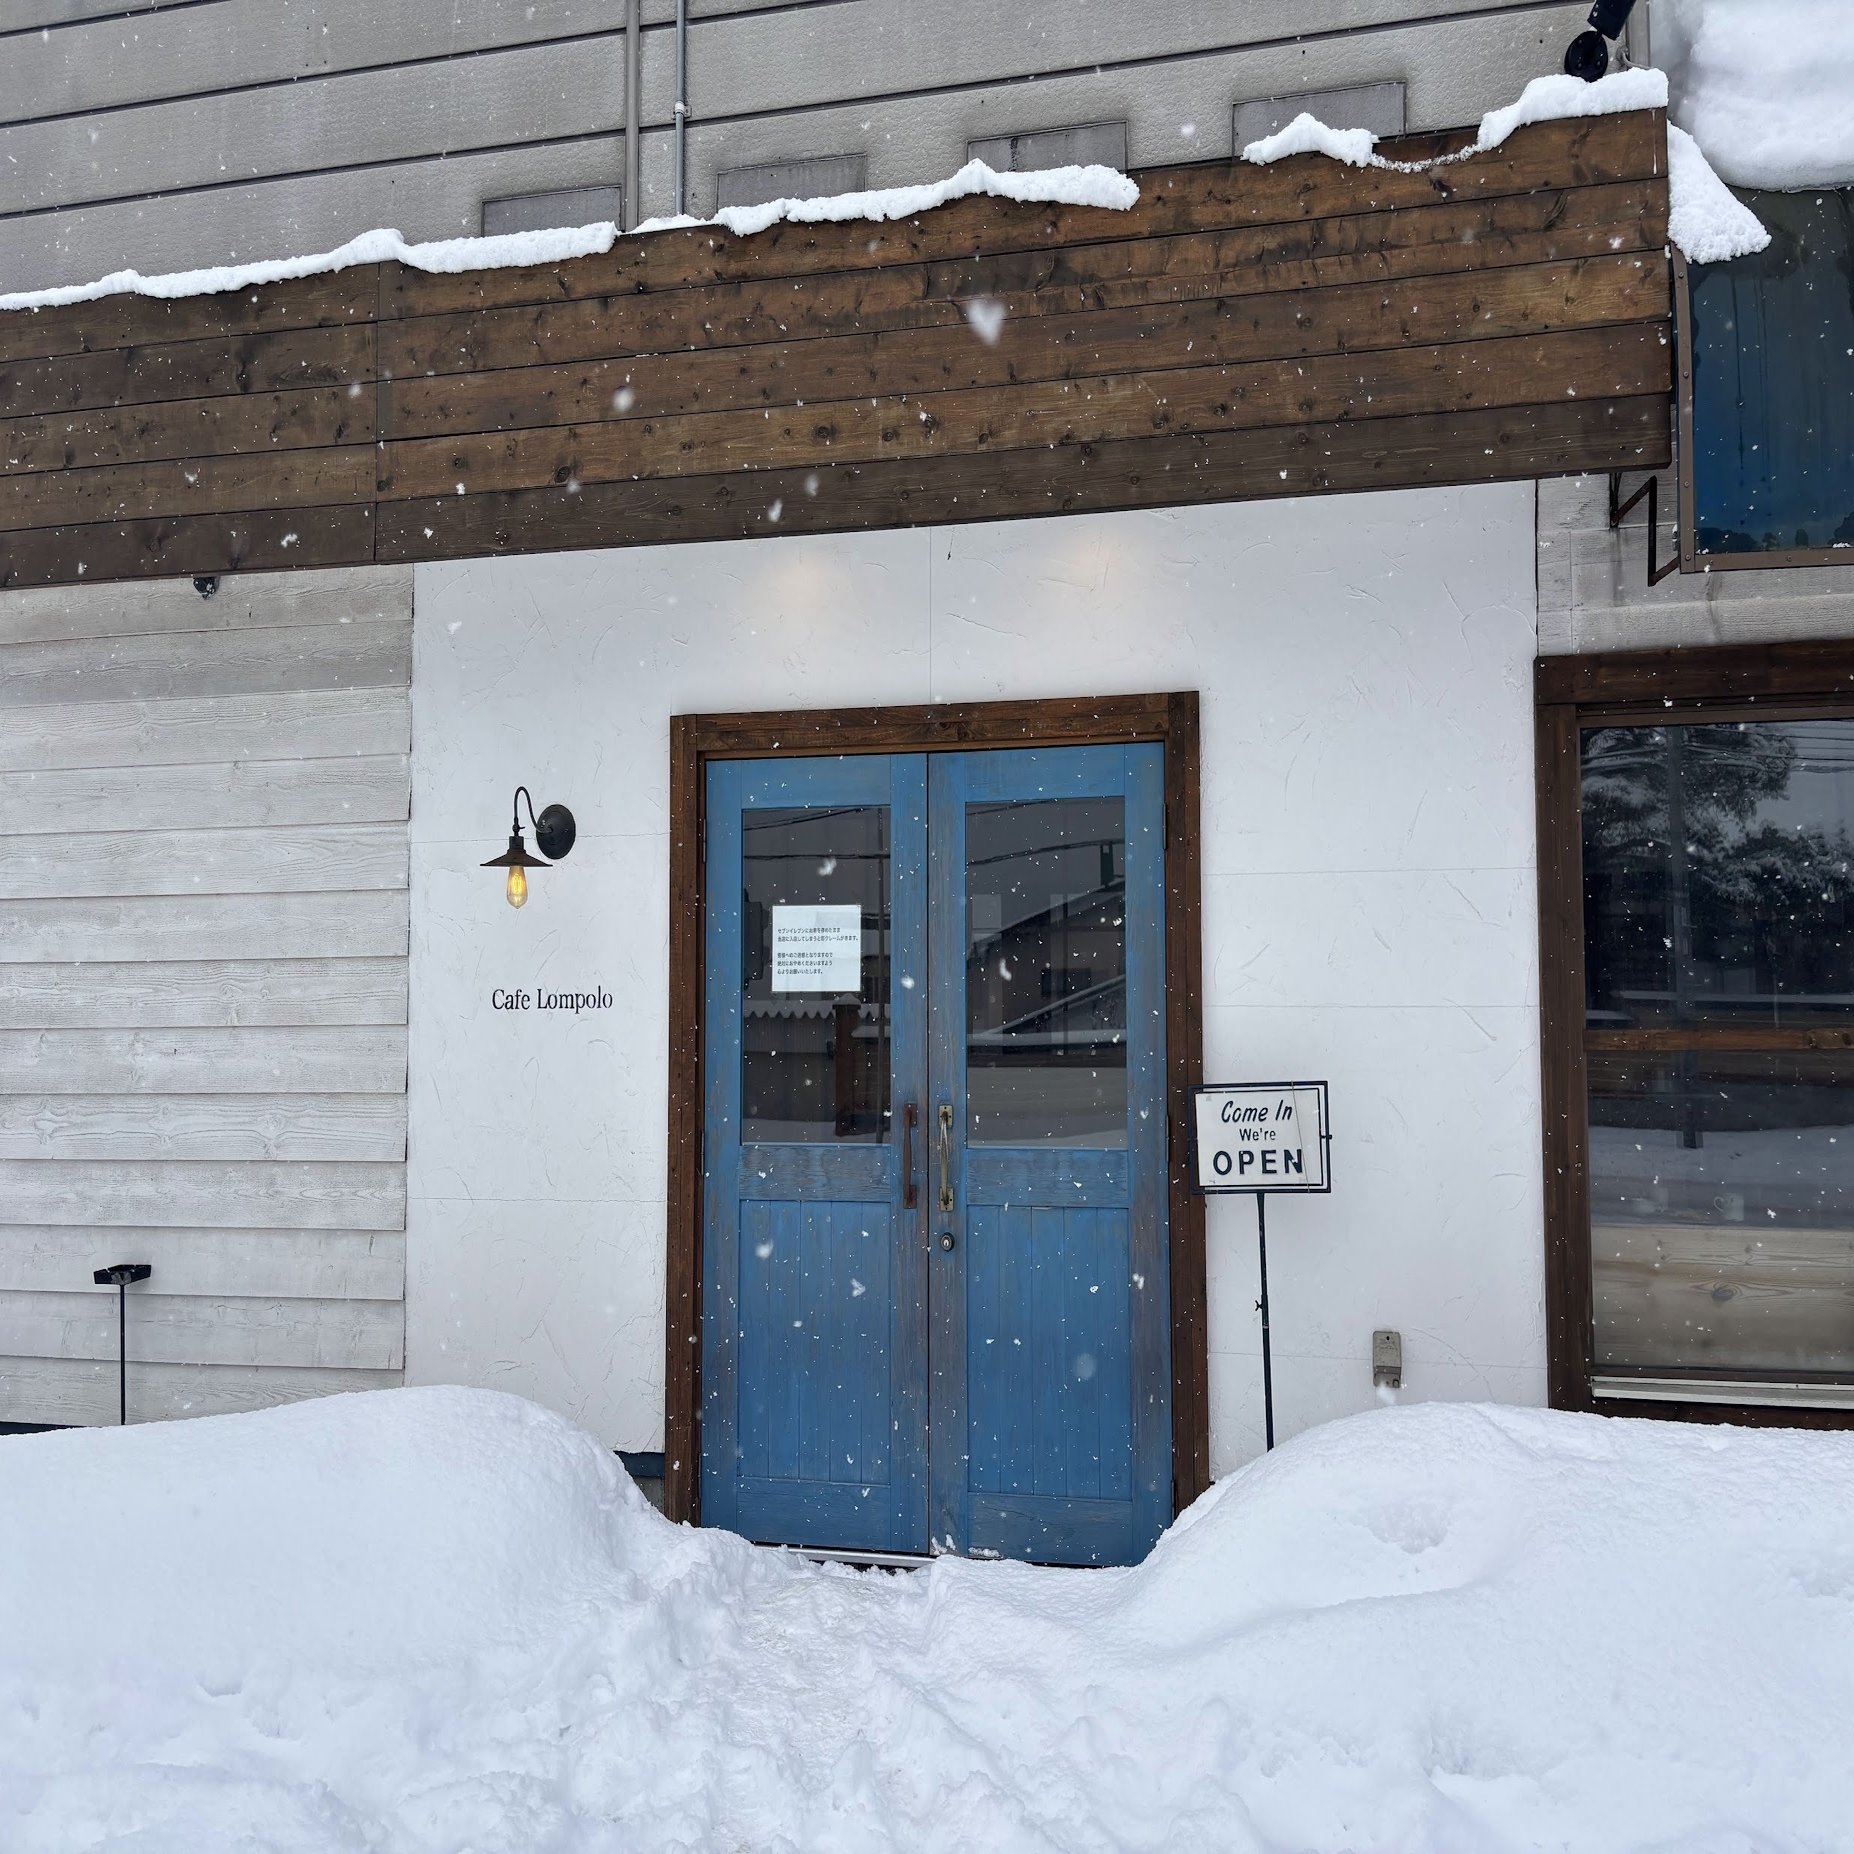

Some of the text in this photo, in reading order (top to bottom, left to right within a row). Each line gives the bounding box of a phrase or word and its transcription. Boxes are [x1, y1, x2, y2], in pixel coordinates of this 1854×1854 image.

[492, 985, 613, 1014] Cafe Lompolo
[1221, 1099, 1293, 1123] Come In
[1239, 1127, 1277, 1141] We're
[1213, 1148, 1303, 1175] OPEN
